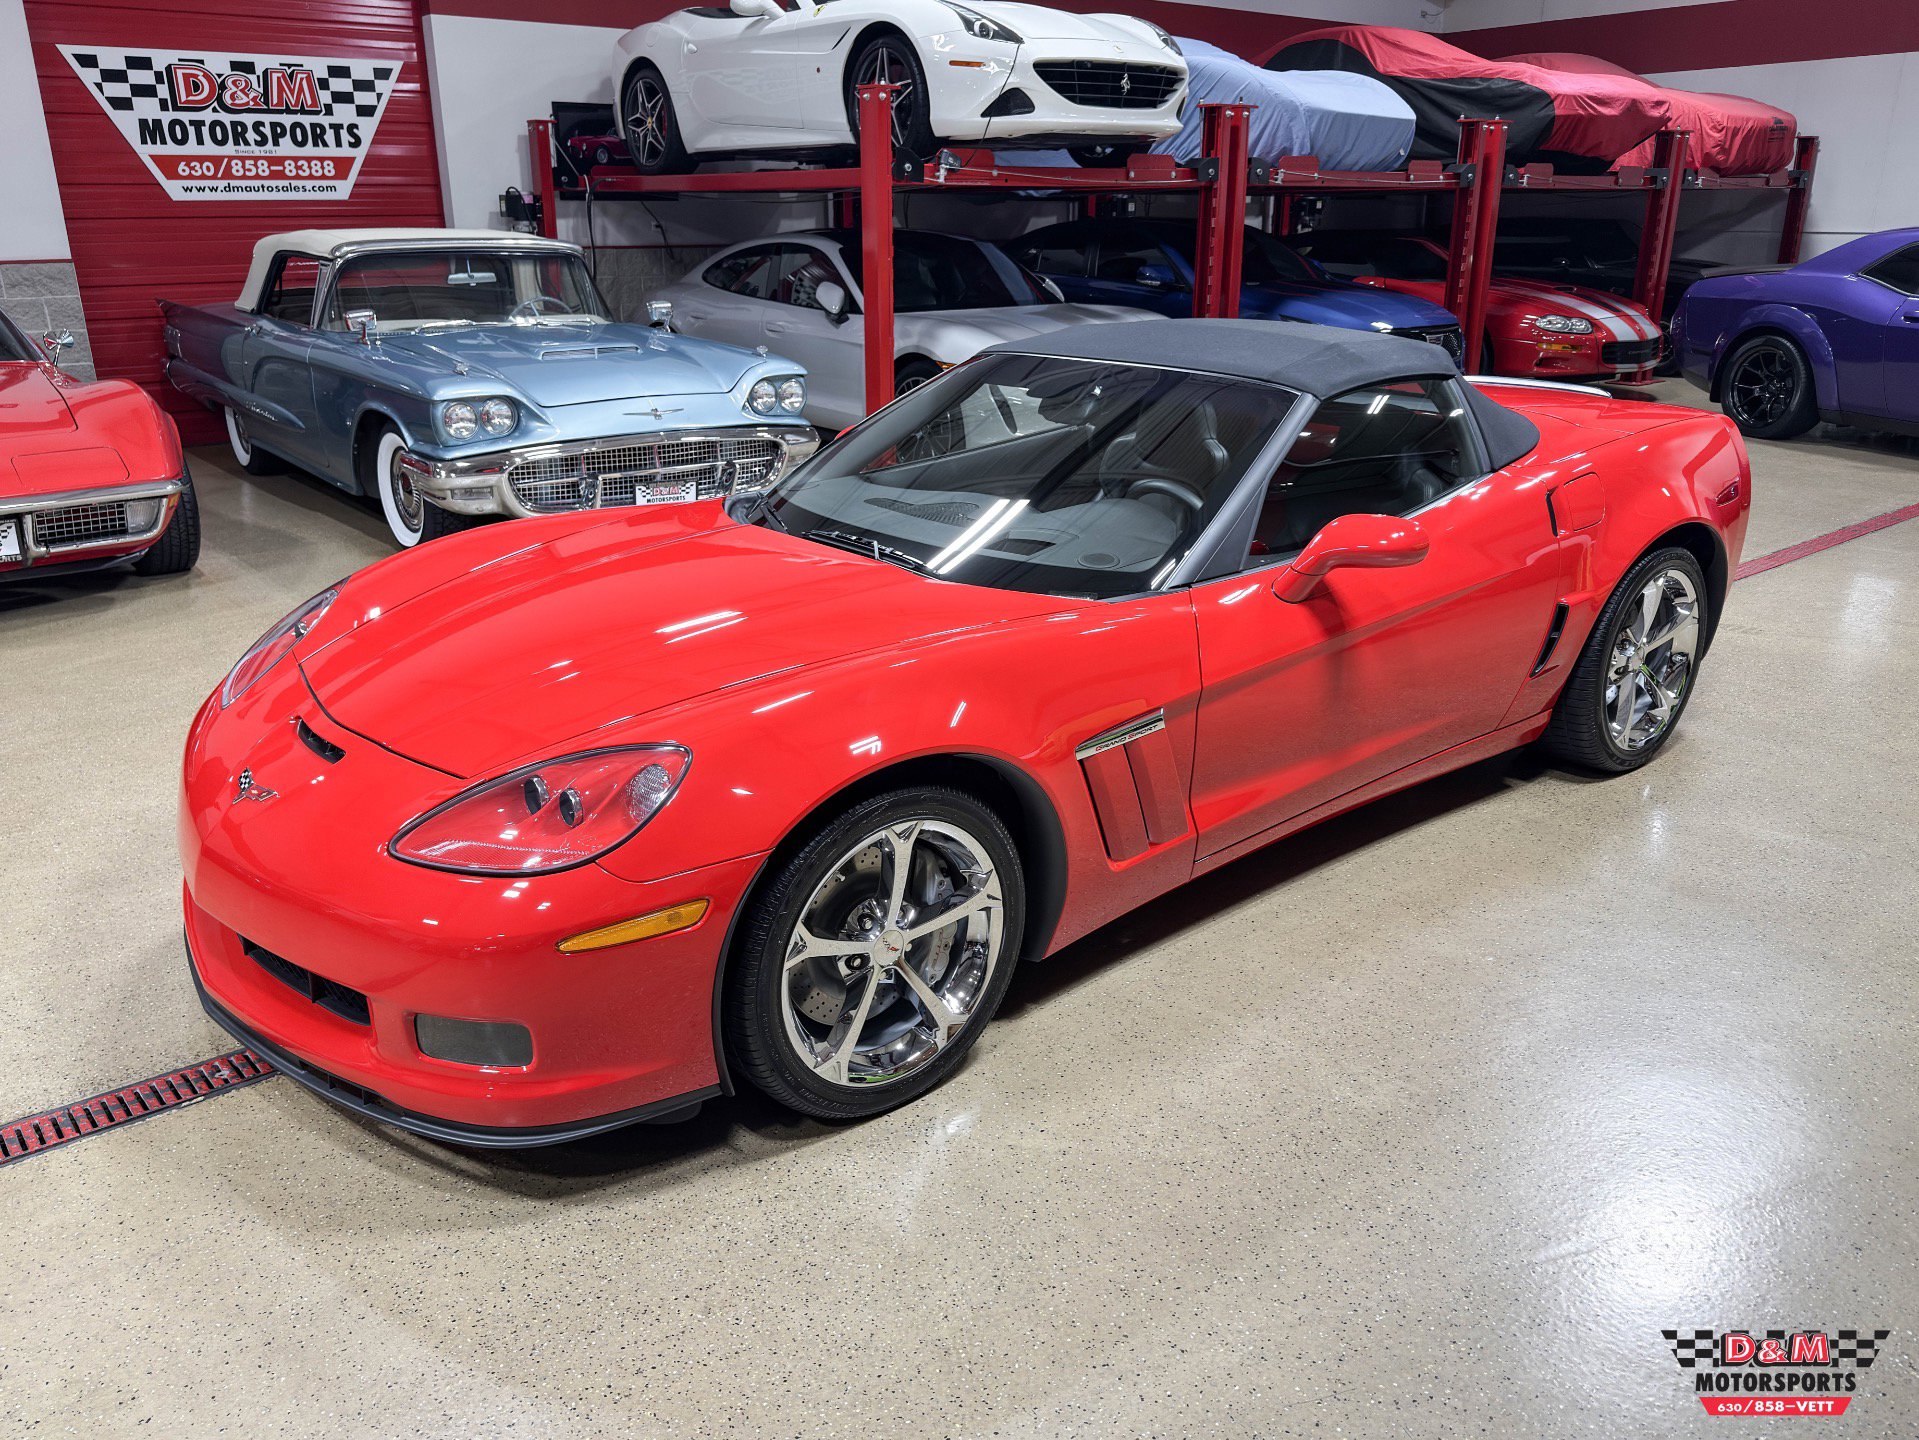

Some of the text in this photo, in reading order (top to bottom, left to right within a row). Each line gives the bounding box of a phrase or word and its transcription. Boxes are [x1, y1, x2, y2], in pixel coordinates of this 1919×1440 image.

[165, 63, 323, 115] D&M
[138, 118, 362, 148] MOTORSPORTS
[182, 183, 337, 194] www.dmautosales.com
[1096, 725, 1158, 751] GRAND SPORT
